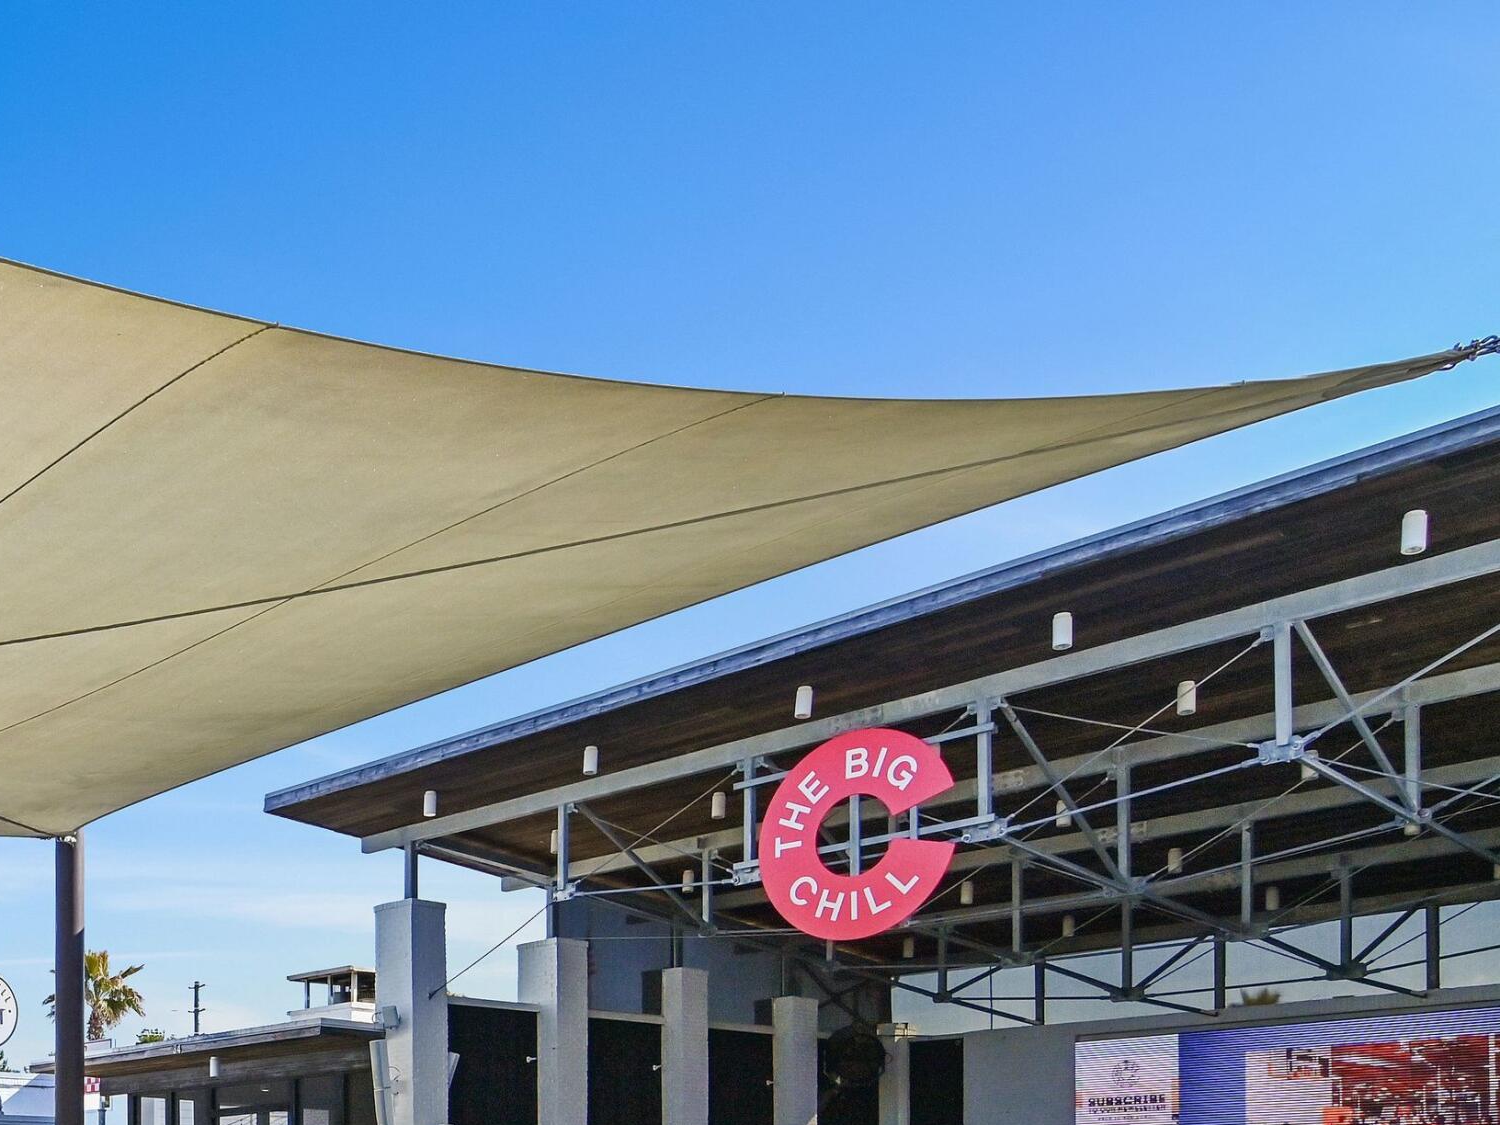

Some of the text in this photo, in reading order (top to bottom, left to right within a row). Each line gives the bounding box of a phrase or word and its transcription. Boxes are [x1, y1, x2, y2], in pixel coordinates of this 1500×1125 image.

[774, 746, 918, 859] THE BIG
[789, 871, 920, 922] CHILL
